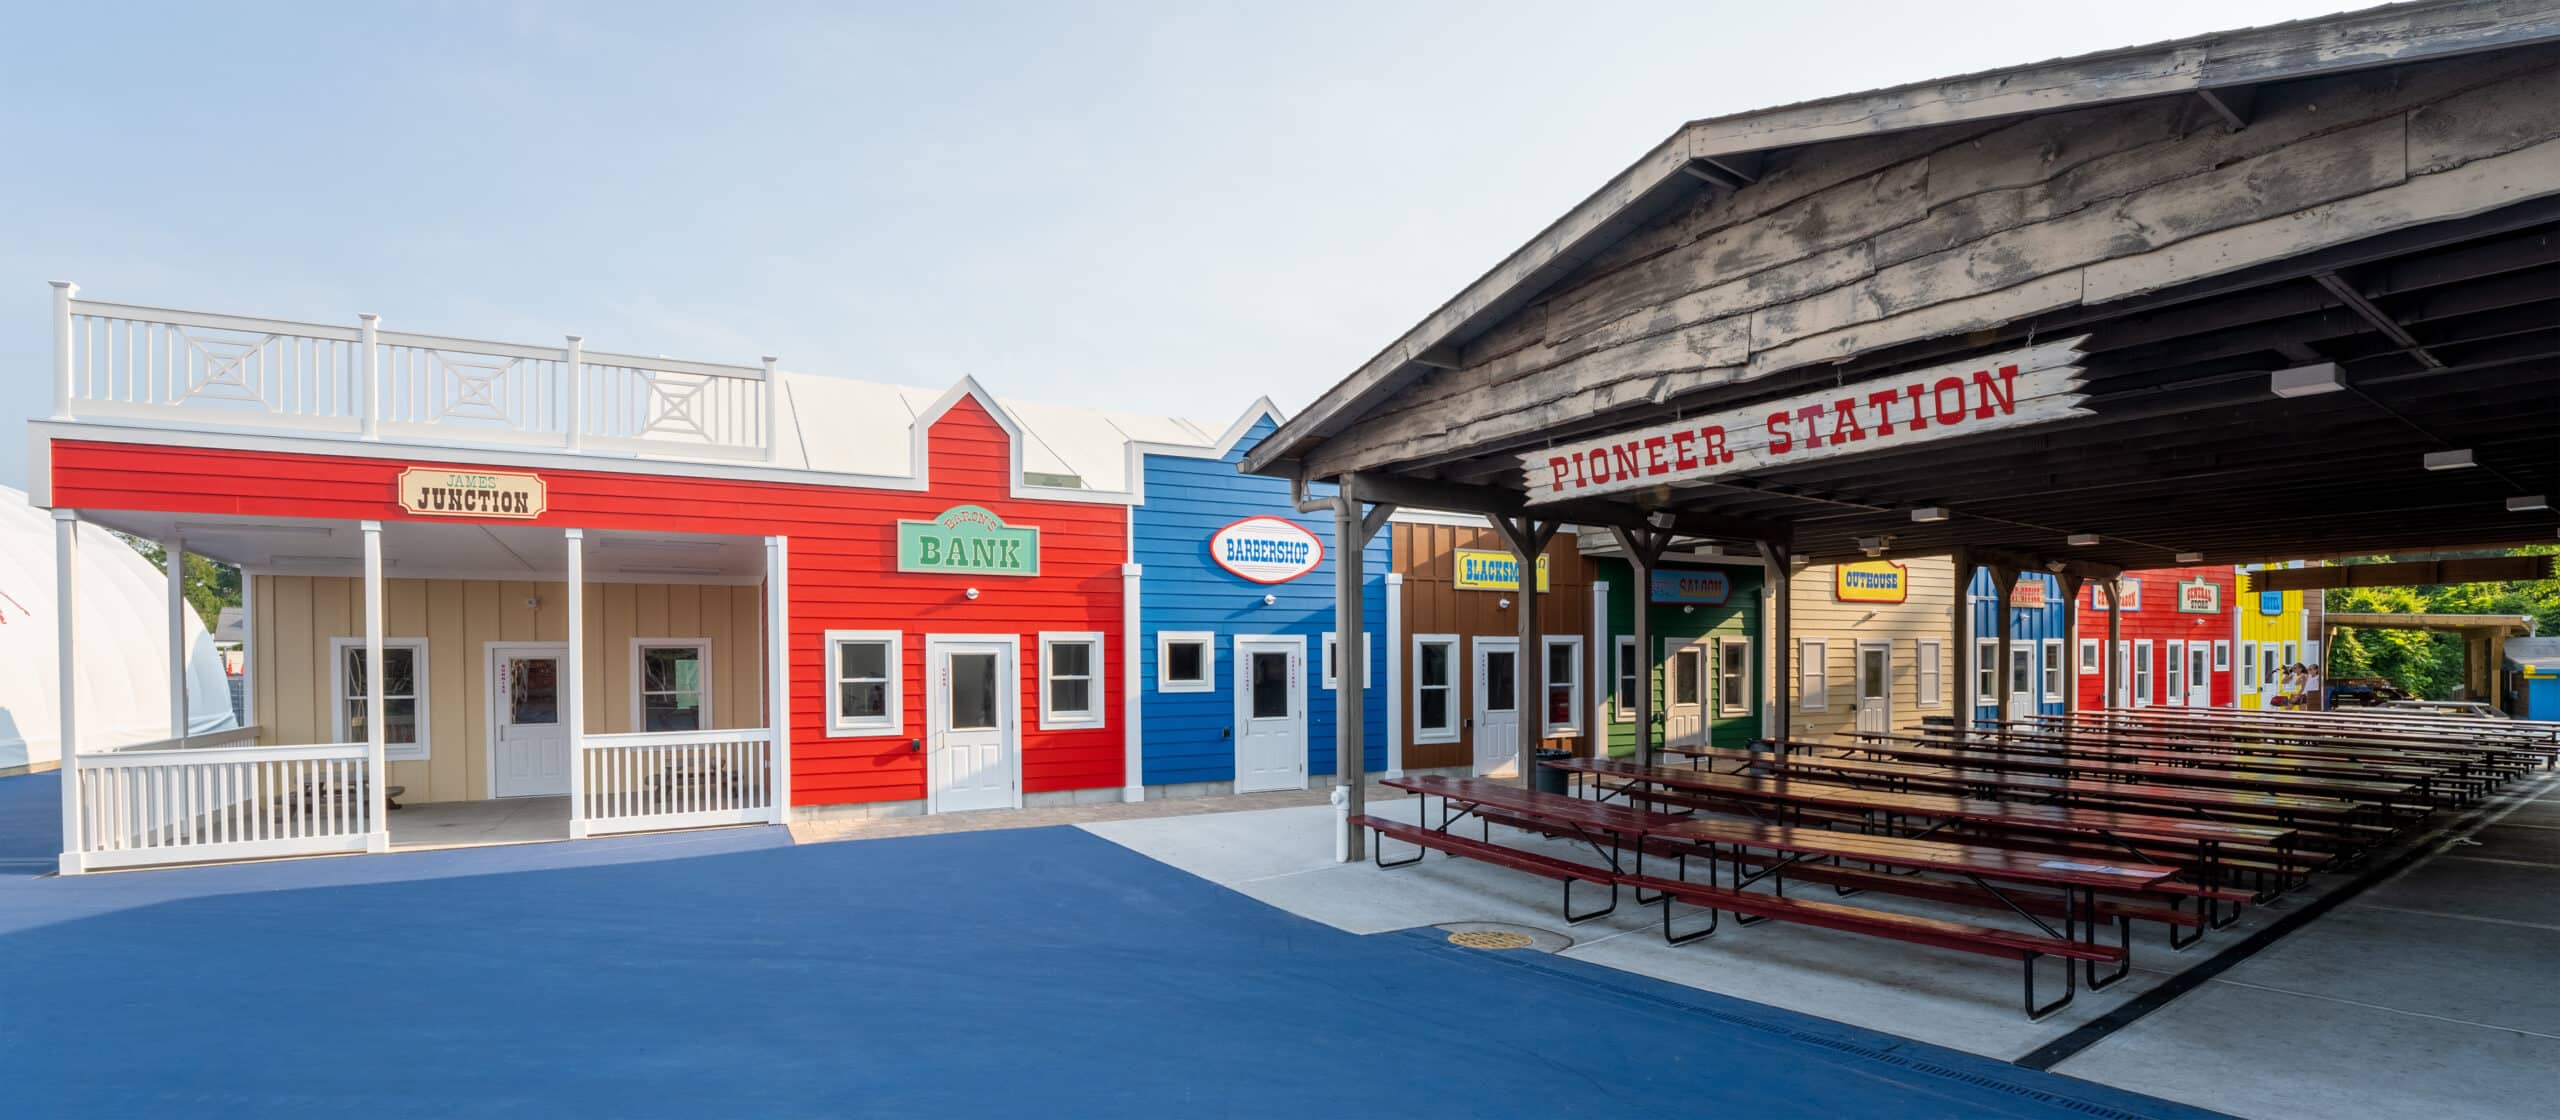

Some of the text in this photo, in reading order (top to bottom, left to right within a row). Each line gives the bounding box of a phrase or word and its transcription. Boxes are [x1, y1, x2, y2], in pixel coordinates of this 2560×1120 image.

[1549, 364, 2019, 492] PIONEER STATION
[418, 487, 529, 514] JUNCTION
[943, 511, 997, 532] BARON'S
[919, 536, 1020, 568] BANK
[1226, 538, 1309, 565] BARBERSHOP
[1466, 559, 1519, 582] BLACKSM
[1846, 571, 1898, 589] OUTHOUSE
